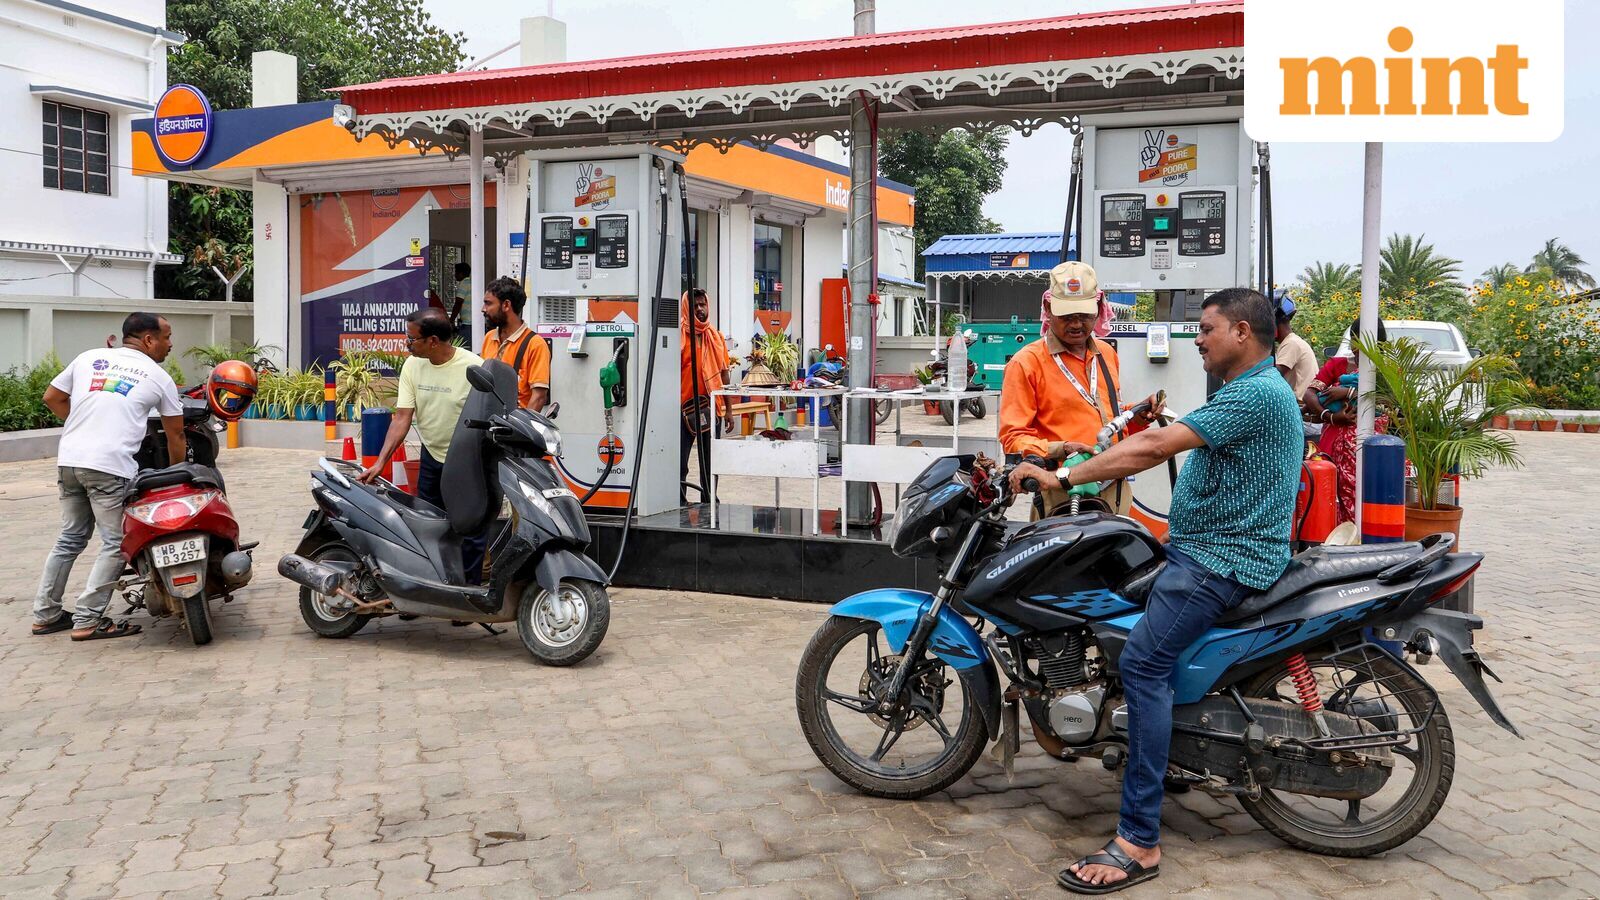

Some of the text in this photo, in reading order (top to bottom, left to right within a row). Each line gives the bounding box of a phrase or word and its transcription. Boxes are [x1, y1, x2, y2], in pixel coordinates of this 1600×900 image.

[158, 117, 204, 134] इंडियनऑयल
[1168, 150, 1188, 161] PURE
[1163, 162, 1188, 175] POORA
[342, 303, 362, 316] MAA
[343, 318, 407, 332] FILLING STATI
[595, 324, 625, 332] PETROL
[119, 374, 140, 384] open
[161, 541, 195, 555] WB 48
[163, 550, 199, 565] D 3257
[986, 536, 1070, 579] GLAMOUR
[1348, 586, 1370, 595] Hero
[1063, 715, 1082, 723] Hero
